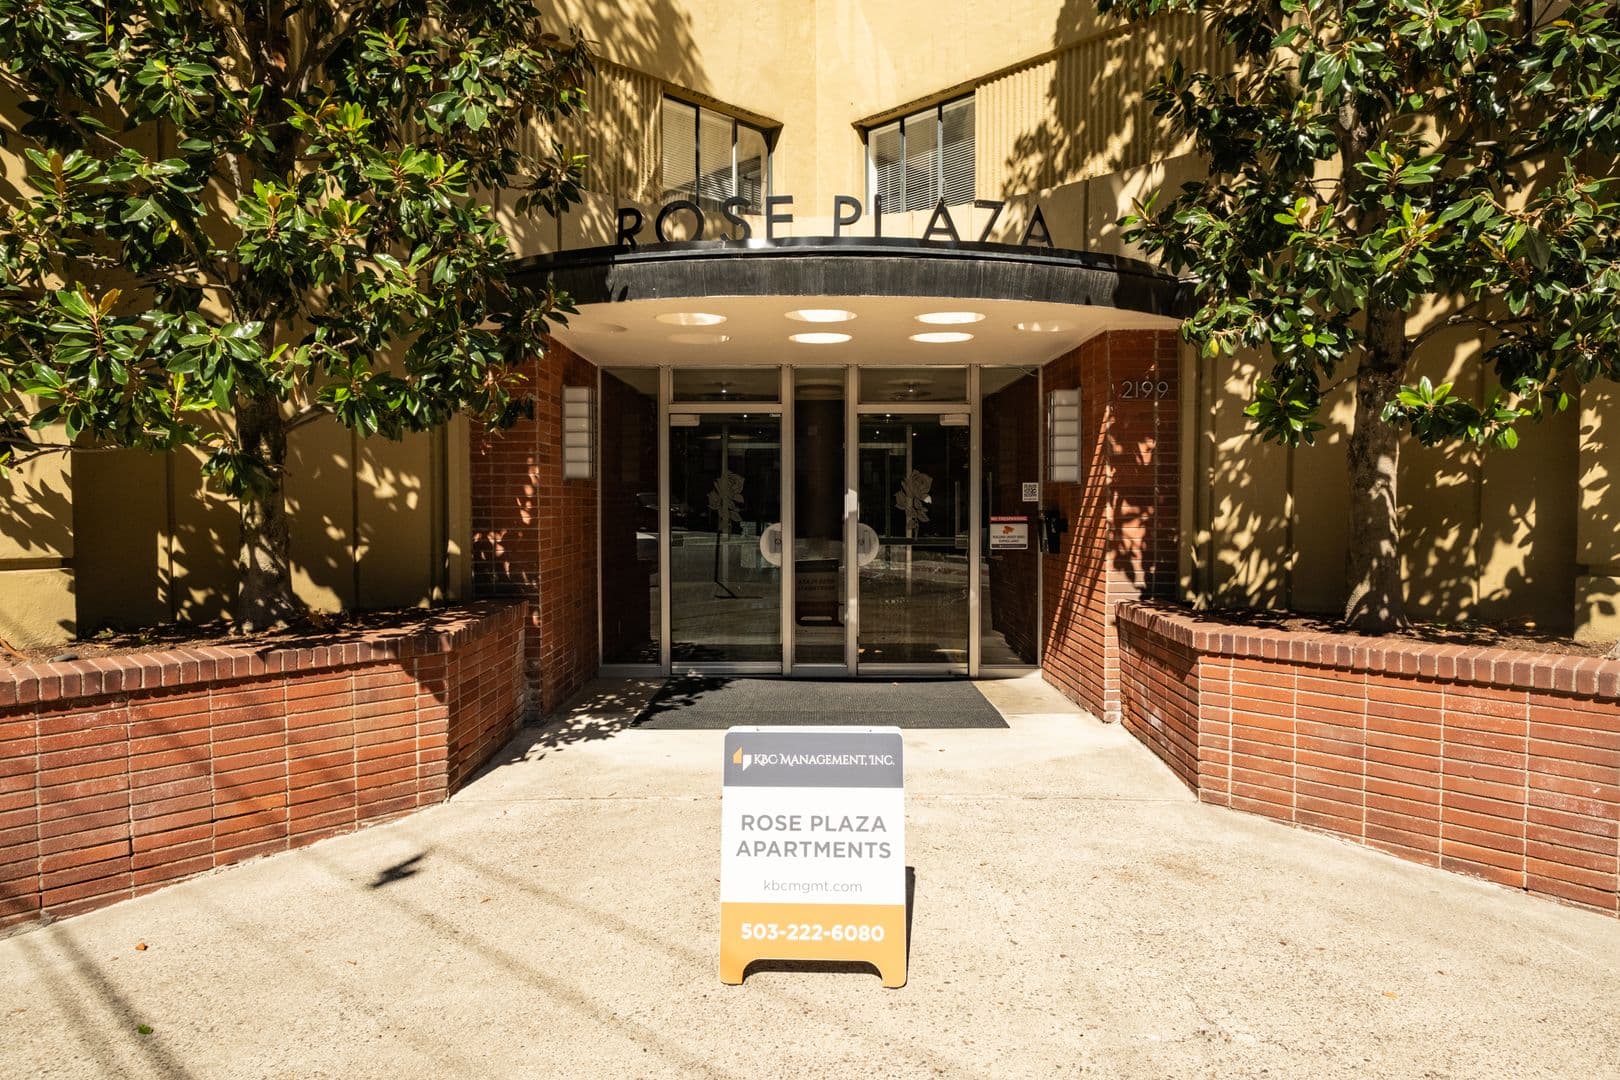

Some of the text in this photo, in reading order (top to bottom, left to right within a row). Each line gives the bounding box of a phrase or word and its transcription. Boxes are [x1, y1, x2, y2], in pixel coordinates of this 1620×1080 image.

[617, 195, 794, 249] ROSE
[1121, 381, 1169, 399] 2199
[754, 753, 778, 767] KBC
[869, 754, 895, 766] INC.
[741, 814, 887, 832] ROSE PLAZA
[736, 840, 891, 859] APARTMENTS
[763, 879, 863, 893] kbcmgmt.com
[741, 923, 885, 942] 503-222-6080
